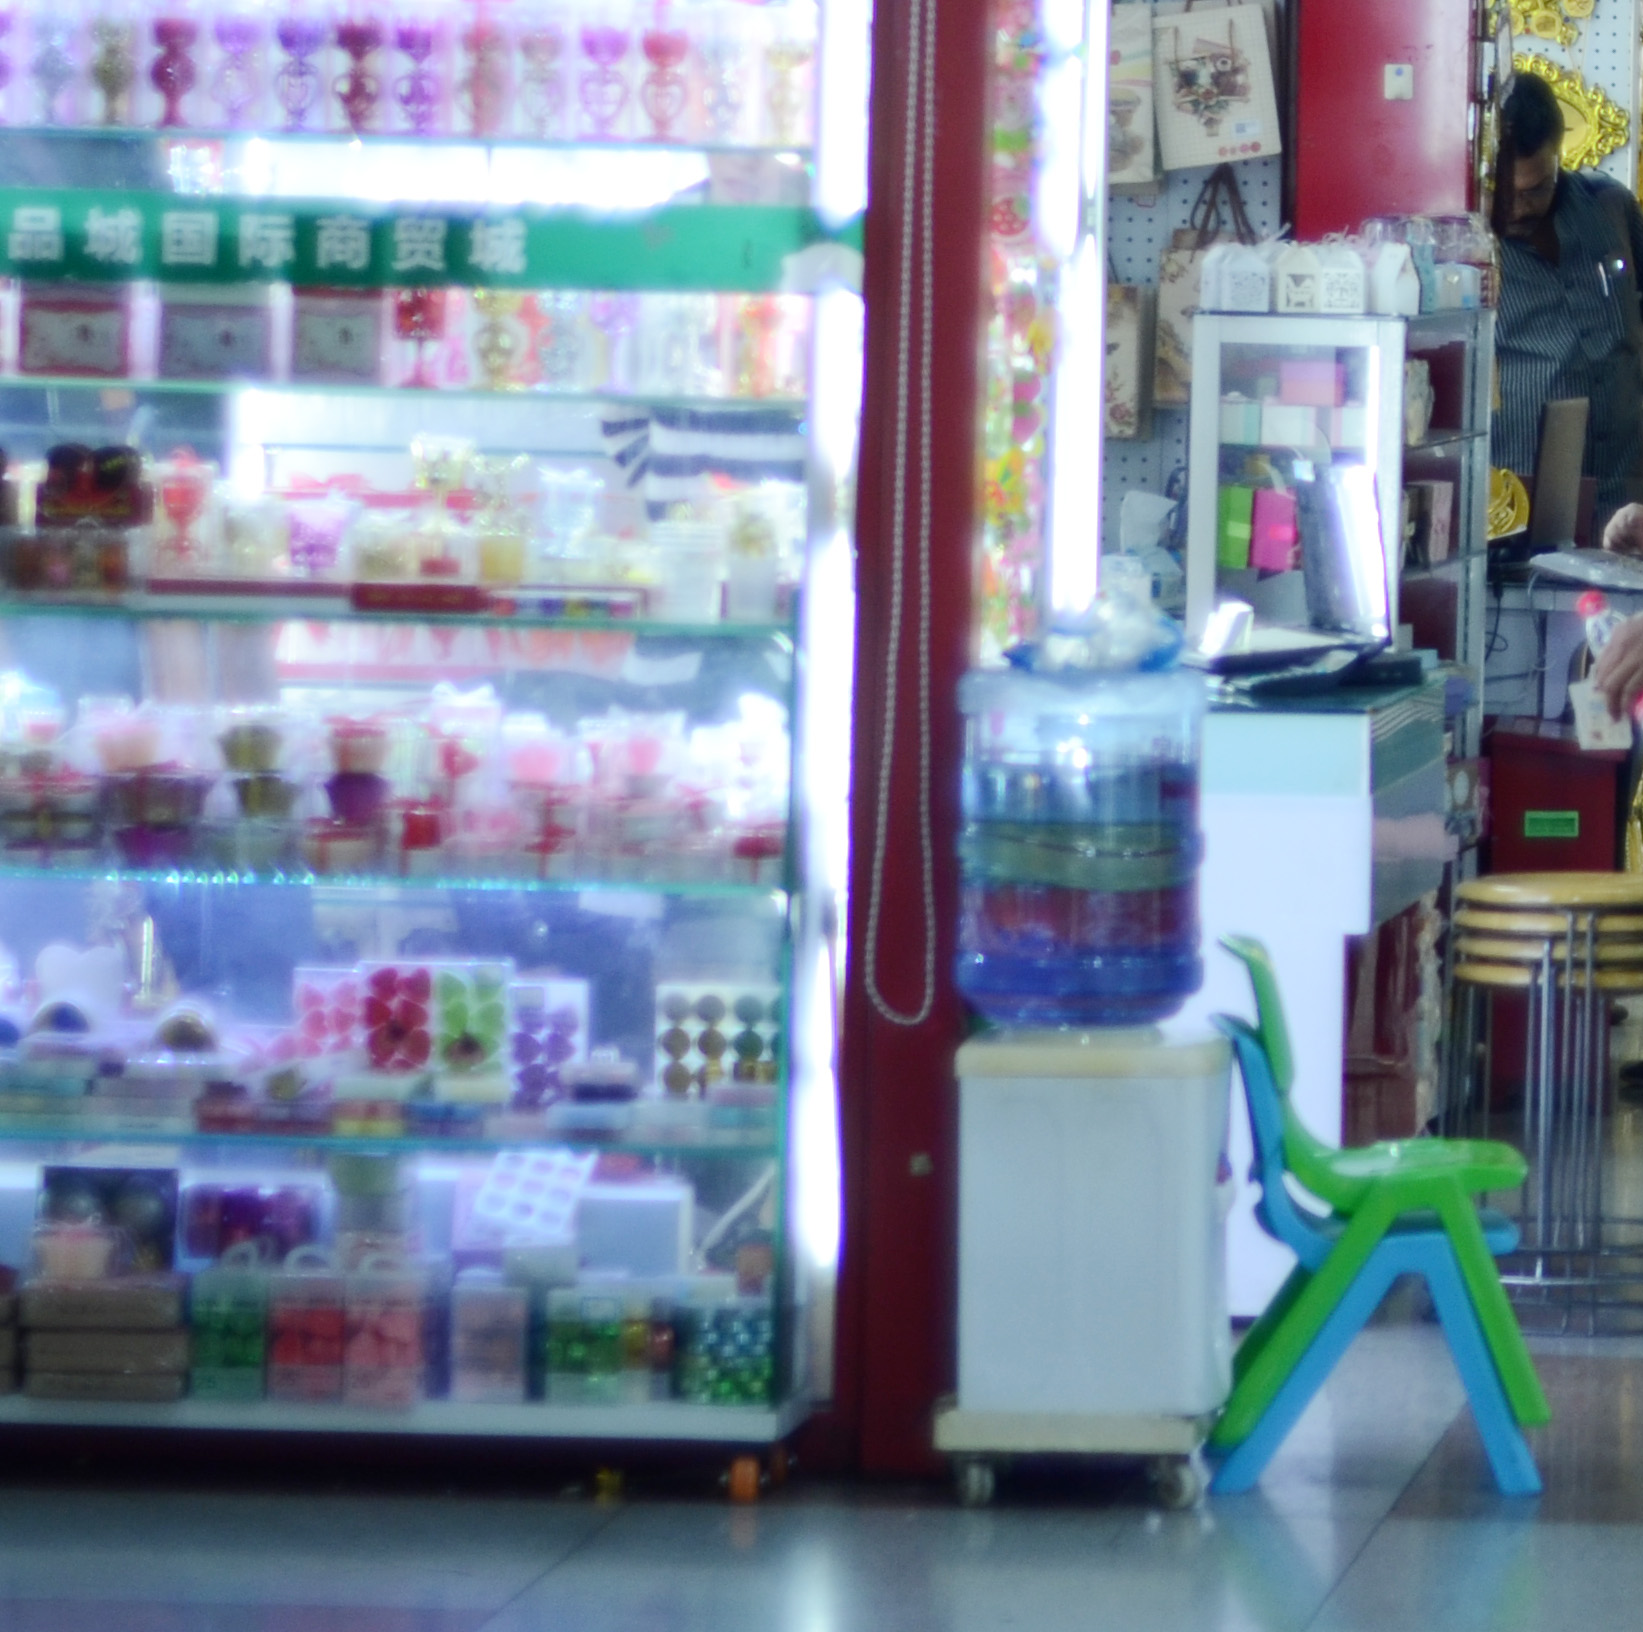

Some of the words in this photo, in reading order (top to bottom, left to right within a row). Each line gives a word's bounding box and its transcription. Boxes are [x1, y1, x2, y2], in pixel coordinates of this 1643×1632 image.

[6, 206, 527, 274] 品城国际商贸城
